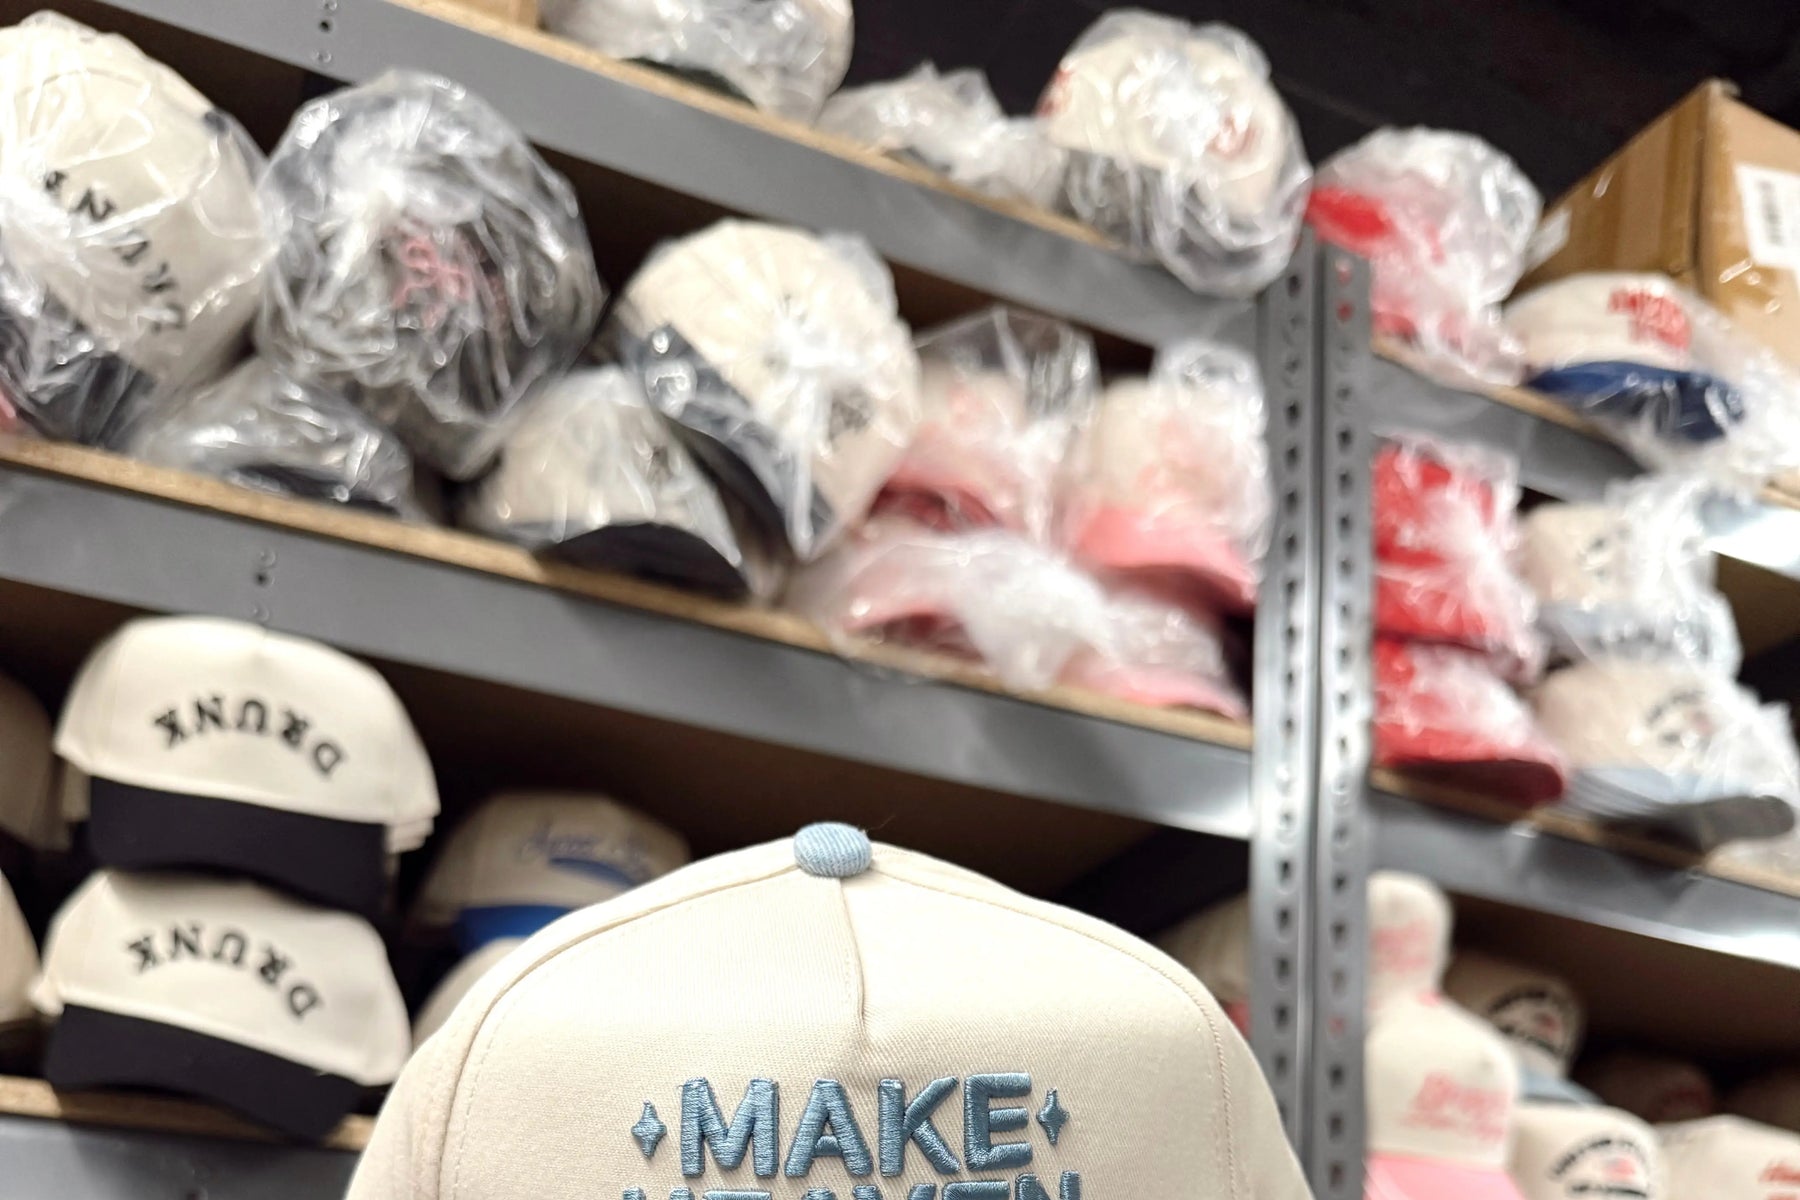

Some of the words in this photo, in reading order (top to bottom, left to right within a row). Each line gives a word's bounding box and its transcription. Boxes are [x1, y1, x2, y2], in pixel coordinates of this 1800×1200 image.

[153, 696, 345, 777] DRUNK
[127, 924, 324, 1021] DRUNK
[680, 1072, 1034, 1178] MAKE
